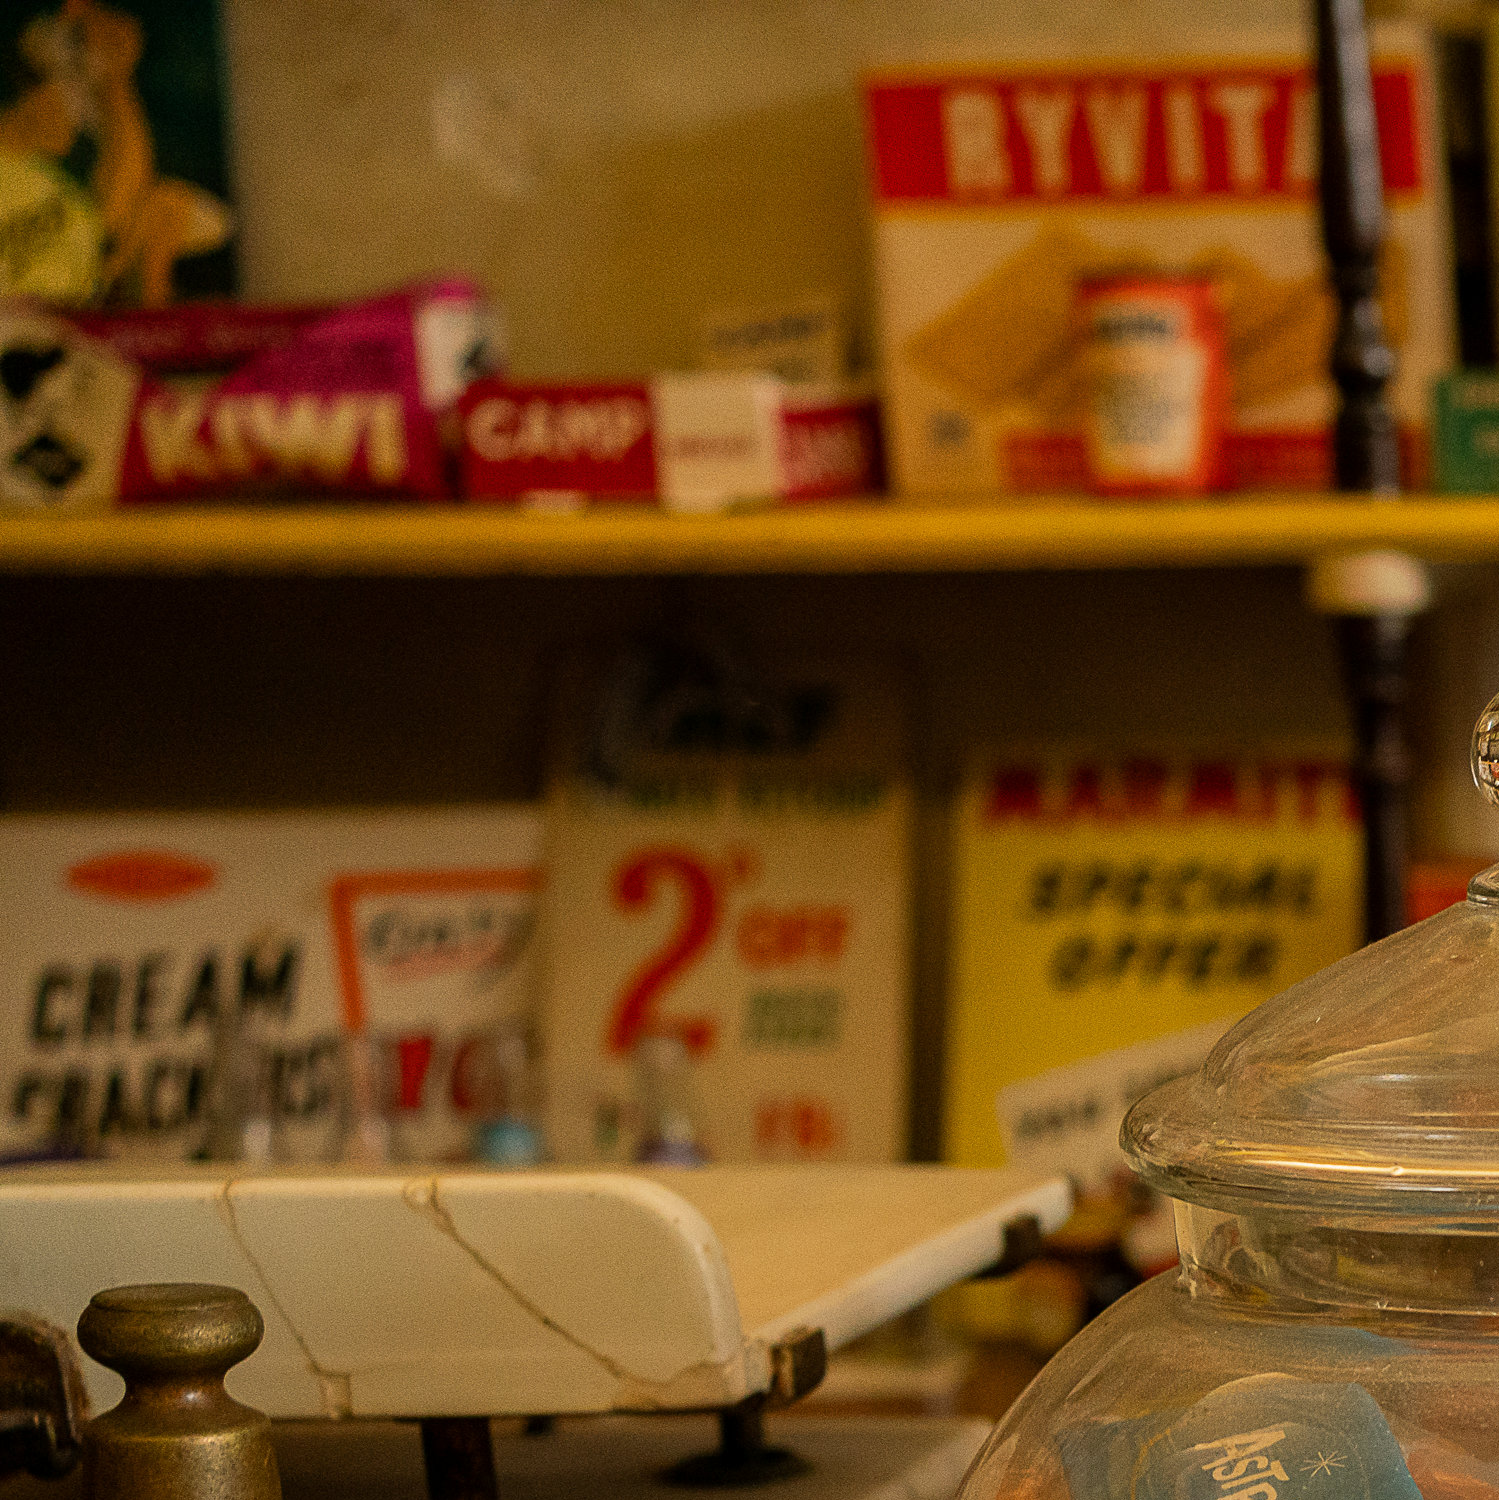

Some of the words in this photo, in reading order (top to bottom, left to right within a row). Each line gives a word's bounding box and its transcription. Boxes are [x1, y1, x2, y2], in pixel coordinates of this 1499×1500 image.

[137, 393, 410, 487] KIWI
[463, 396, 648, 463] CAMP
[1028, 857, 1320, 917] SPECIAL
[607, 845, 725, 1058] 2
[736, 906, 853, 970] OFF
[1048, 932, 1280, 990] OFFER
[30, 940, 305, 1046] CREAM
